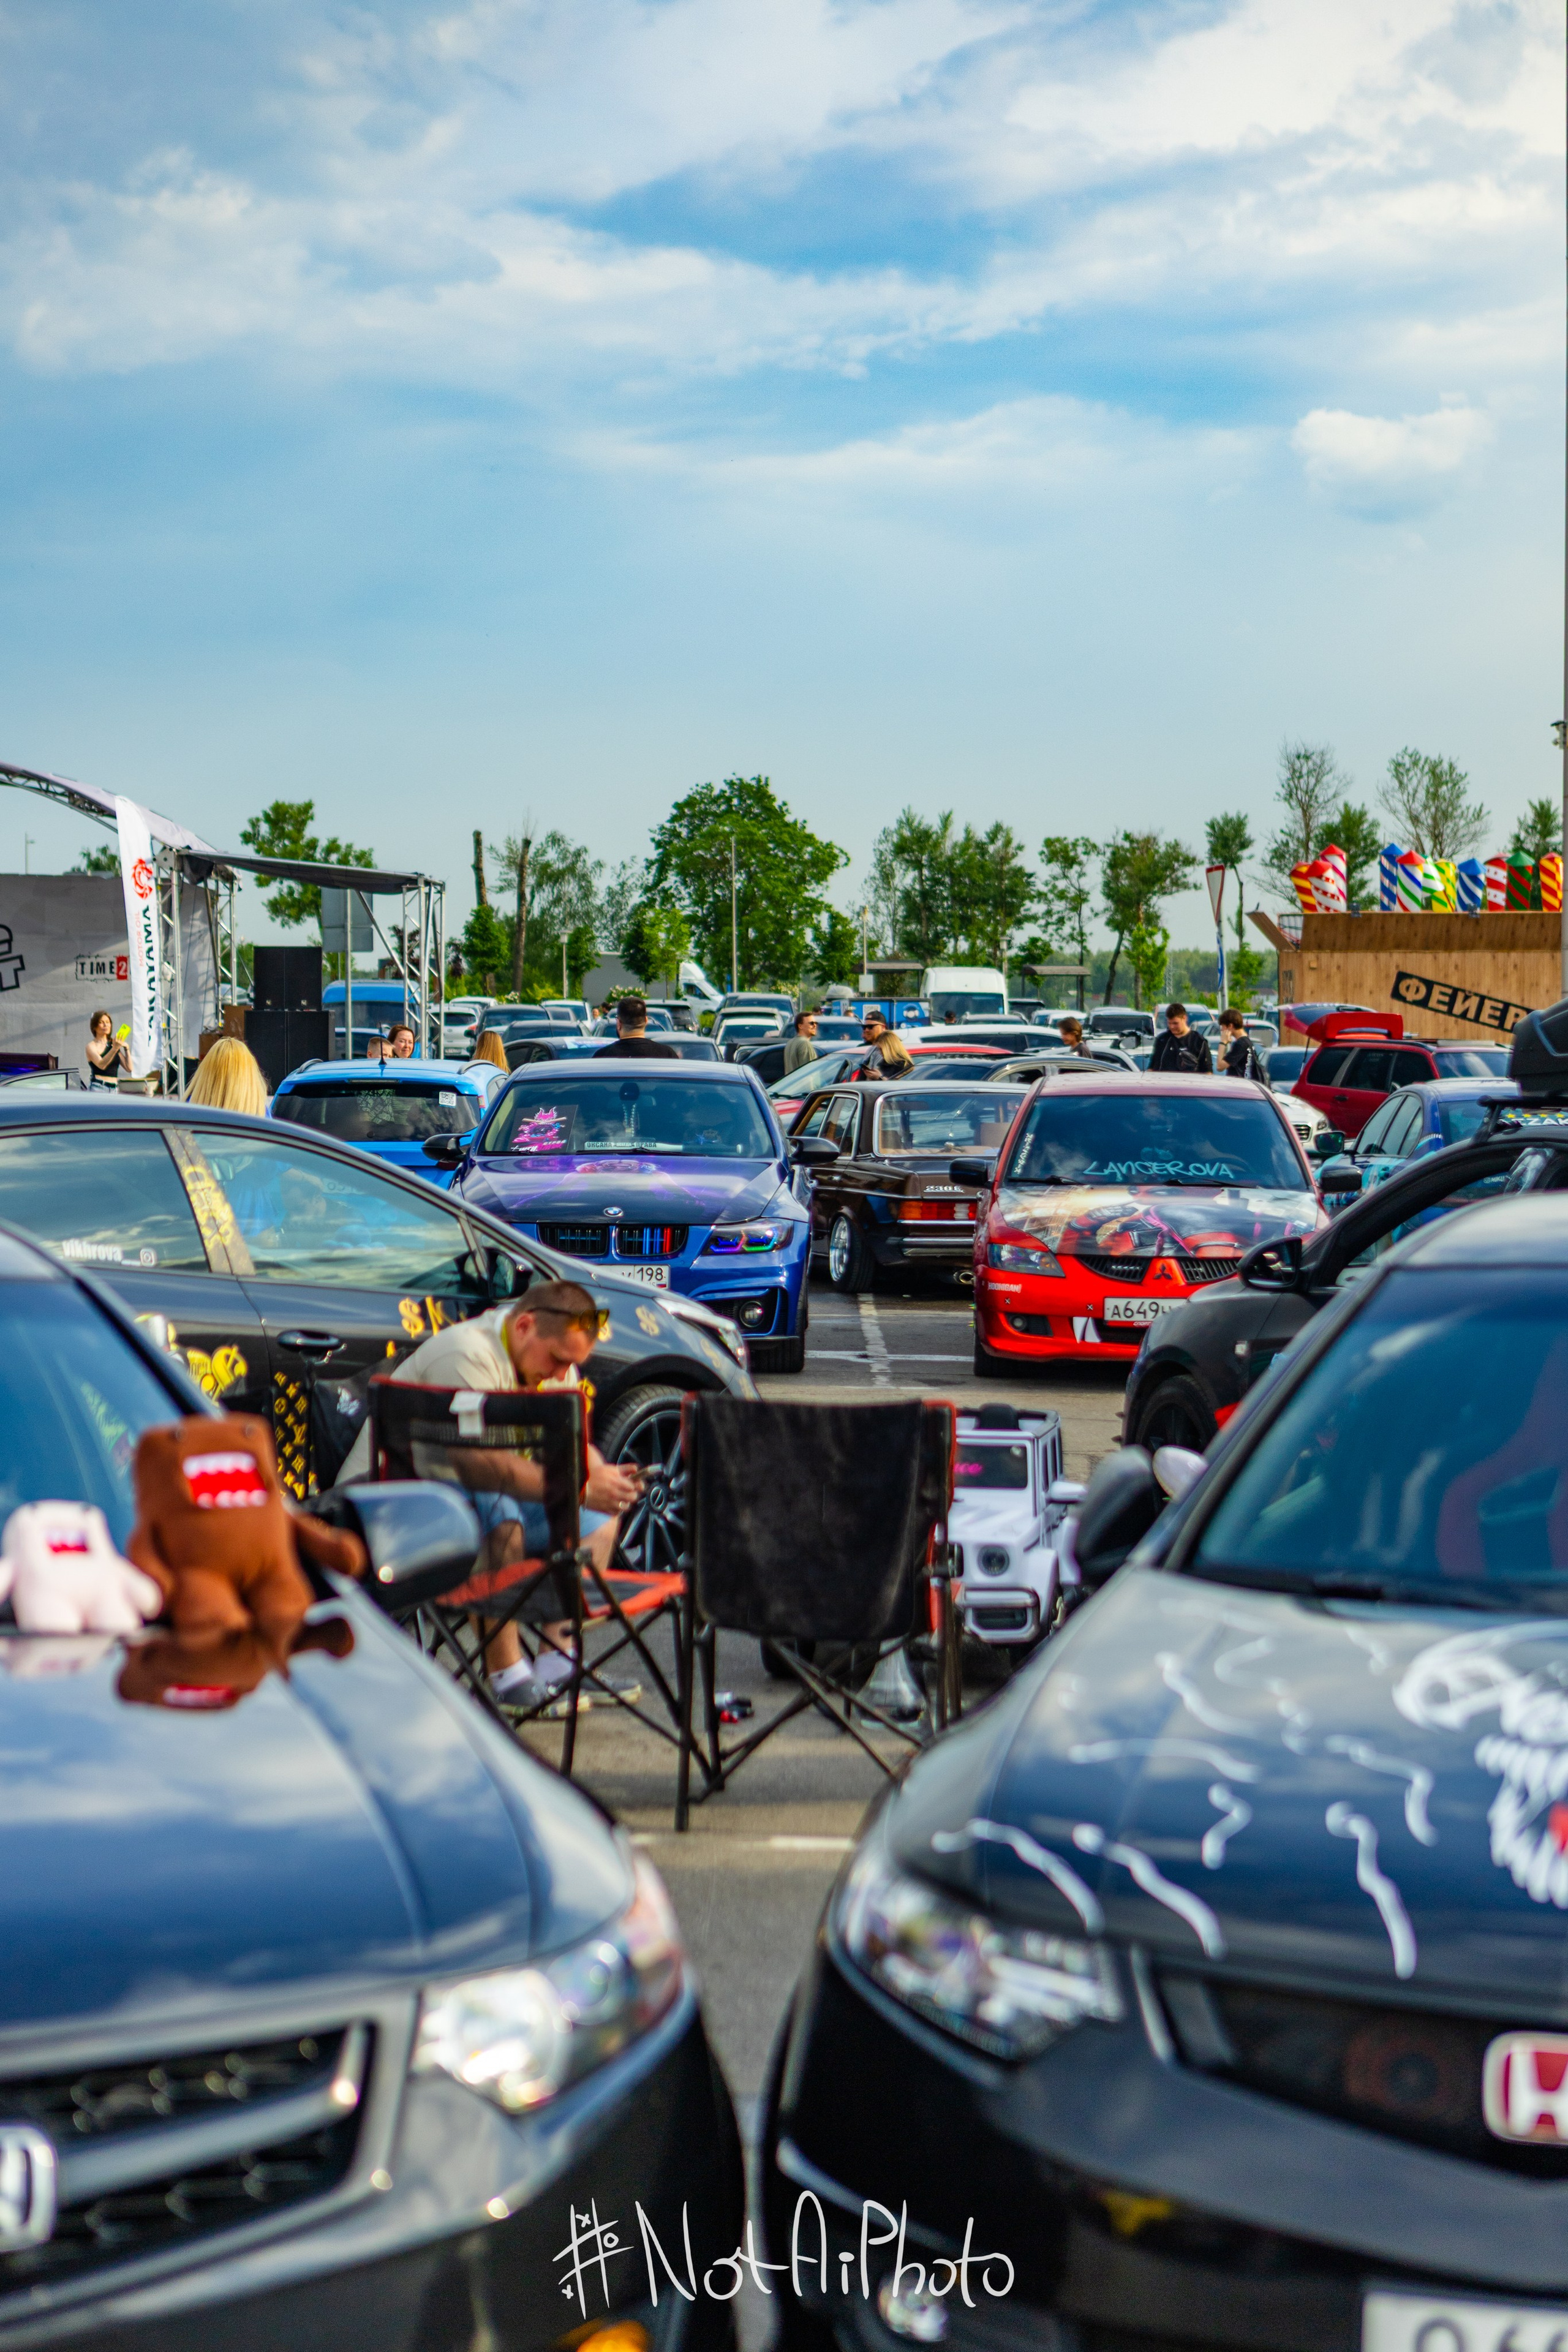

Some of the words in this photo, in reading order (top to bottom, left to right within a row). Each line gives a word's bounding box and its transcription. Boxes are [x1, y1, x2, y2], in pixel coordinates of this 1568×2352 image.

[79, 960, 131, 976] TIME2
[1398, 978, 1528, 1031] ФЕЙЕР
[636, 1267, 663, 1281] 198
